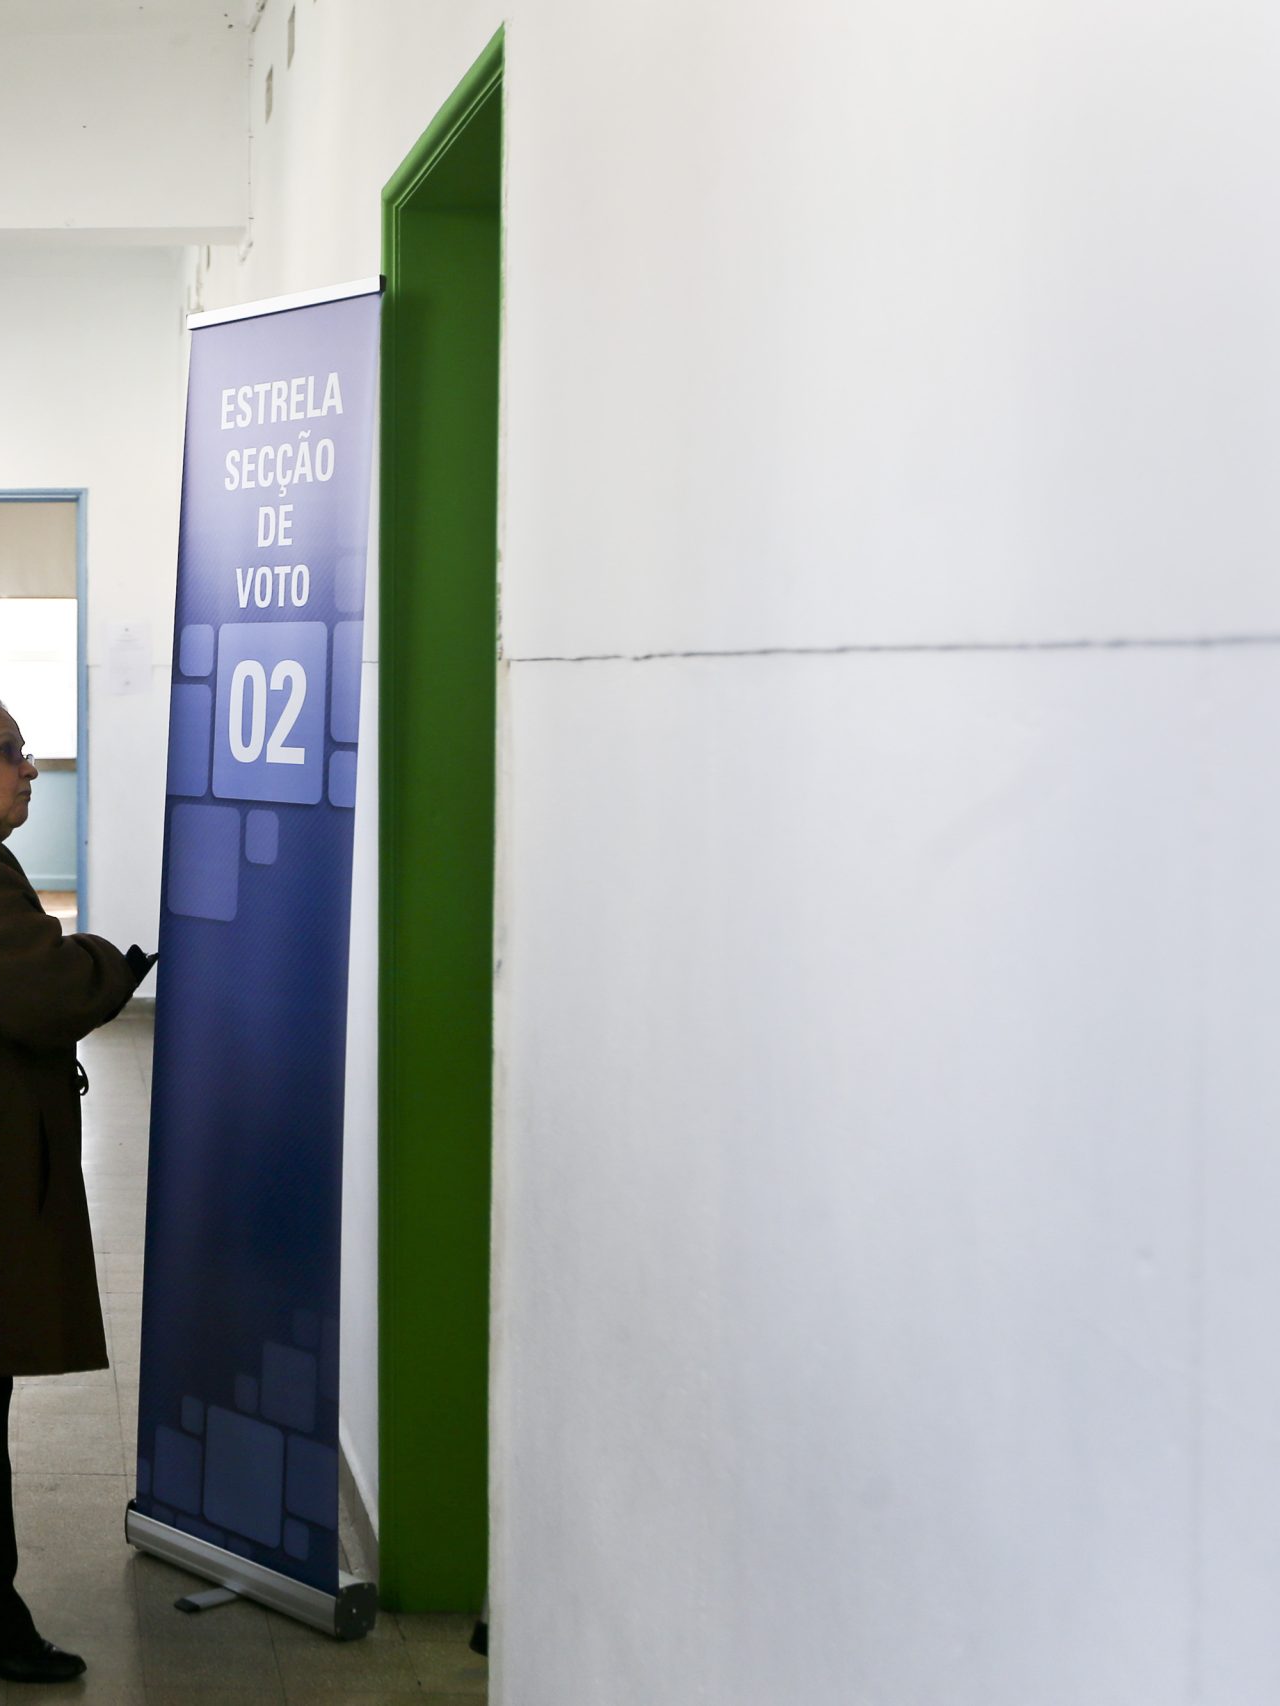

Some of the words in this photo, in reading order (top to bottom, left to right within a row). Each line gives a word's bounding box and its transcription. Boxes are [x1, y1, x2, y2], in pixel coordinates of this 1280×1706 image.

[220, 372, 343, 430] ESTRELA
[224, 430, 335, 497] SECÇÃO
[256, 503, 293, 548] DE
[235, 564, 310, 609] VOTO
[228, 659, 307, 765] 02
